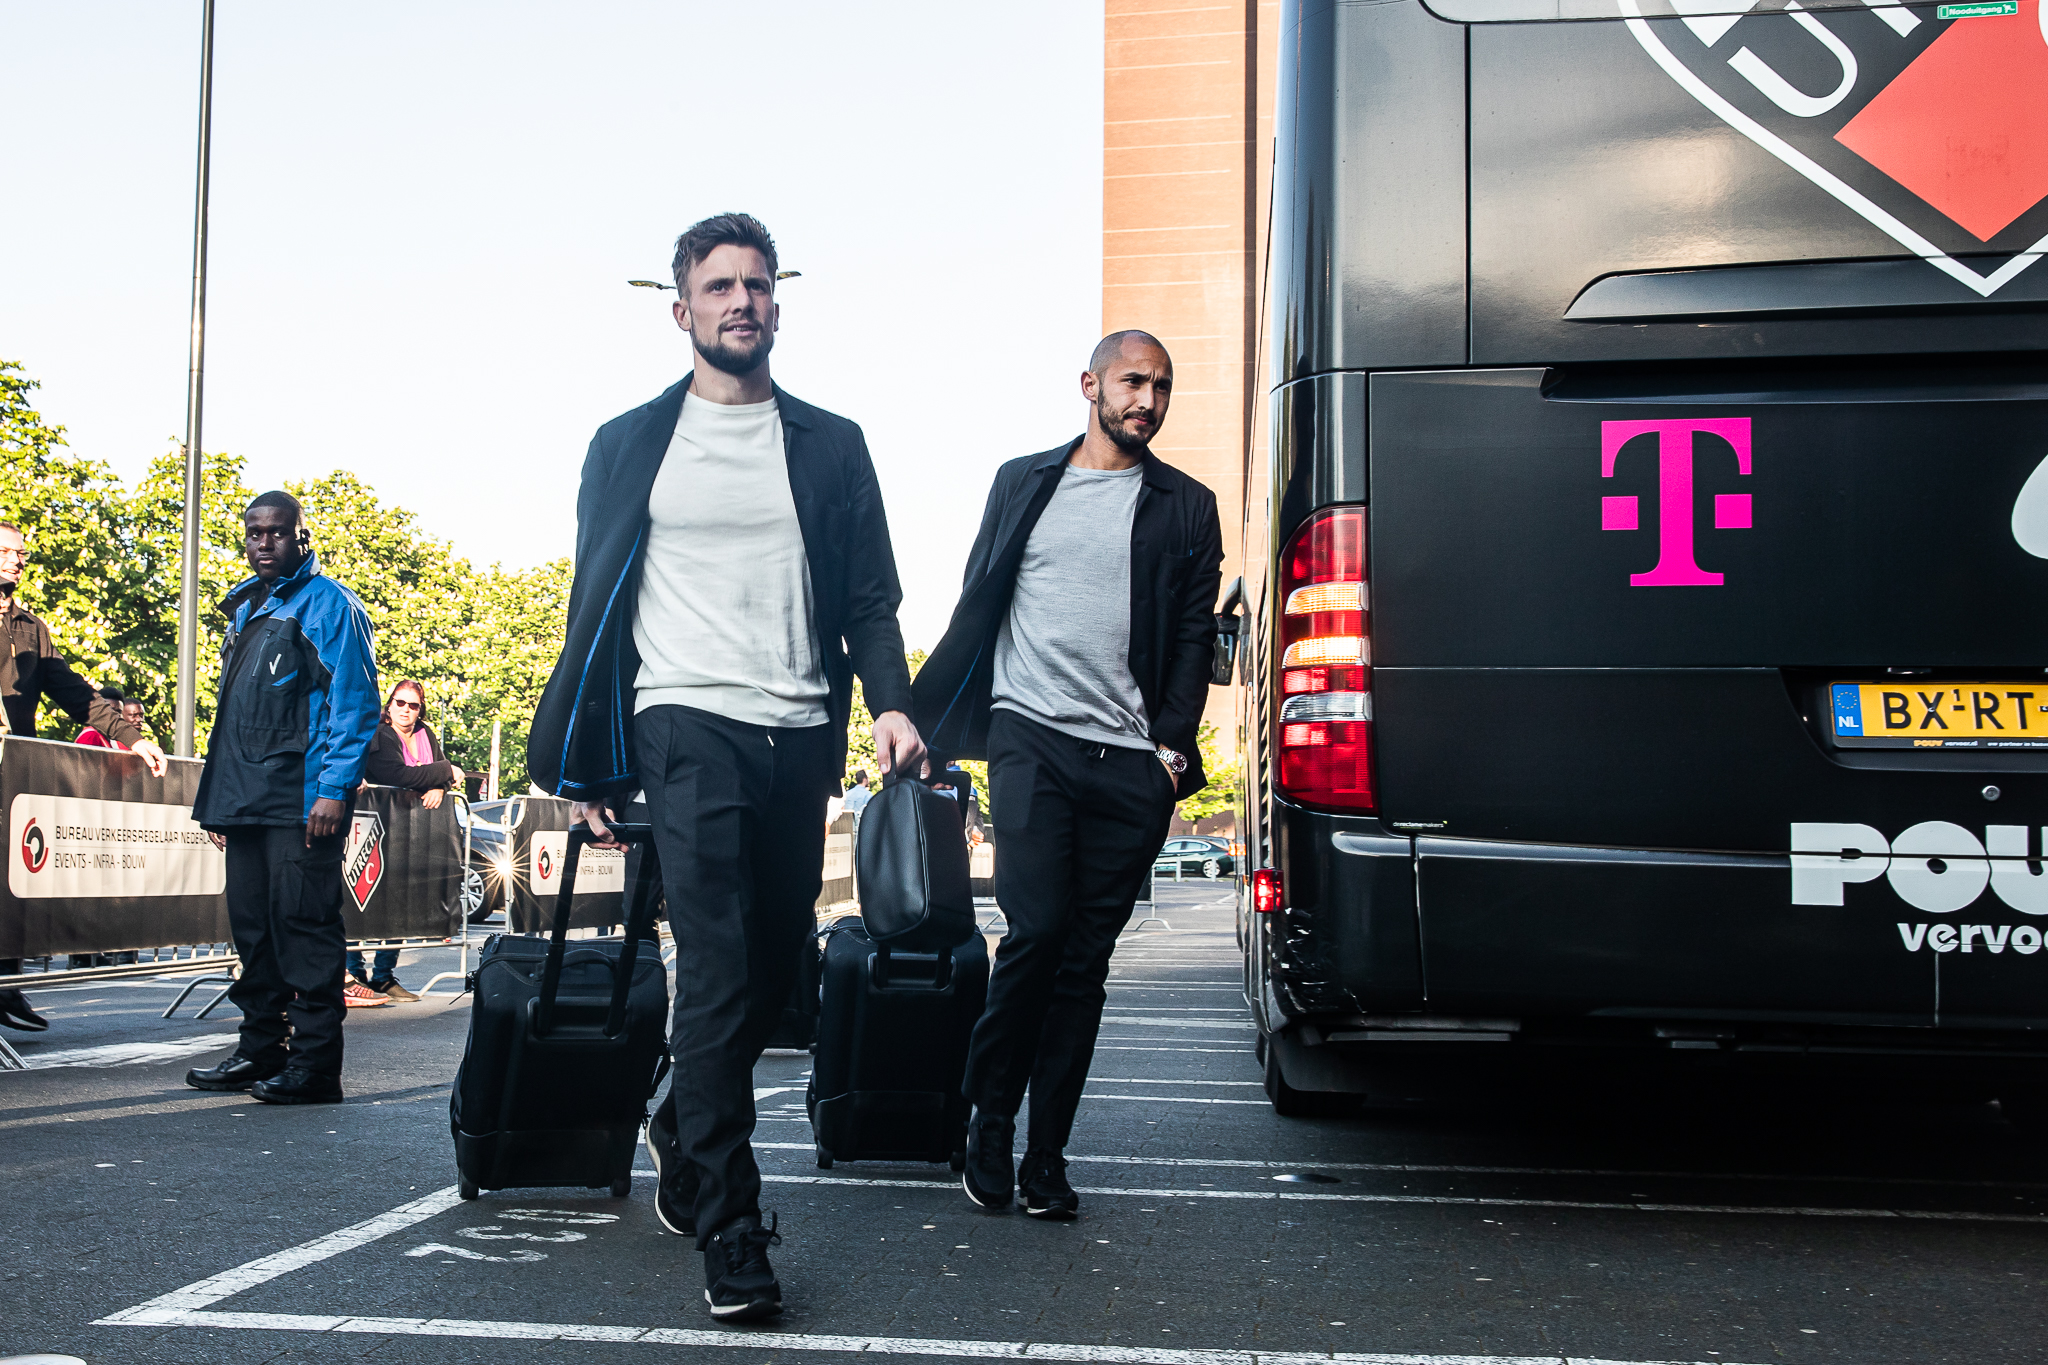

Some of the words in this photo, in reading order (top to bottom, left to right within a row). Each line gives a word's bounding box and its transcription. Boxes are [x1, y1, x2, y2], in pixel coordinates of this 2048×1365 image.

[1949, 6, 2003, 16] Nooduitgang
[1602, 417, 1752, 586] T
[1838, 716, 1859, 728] NL
[55, 825, 93, 841] BUREAU
[95, 828, 179, 844] VERKEERSREGELAAR
[181, 831, 212, 845] NEDERLA
[354, 823, 361, 845] F
[55, 853, 87, 869] EVENTS
[93, 854, 116, 869] INFRA
[122, 855, 146, 869] BOUW
[349, 821, 379, 887] UTRECHT
[365, 862, 374, 885] C
[1897, 923, 2048, 955] vervo
